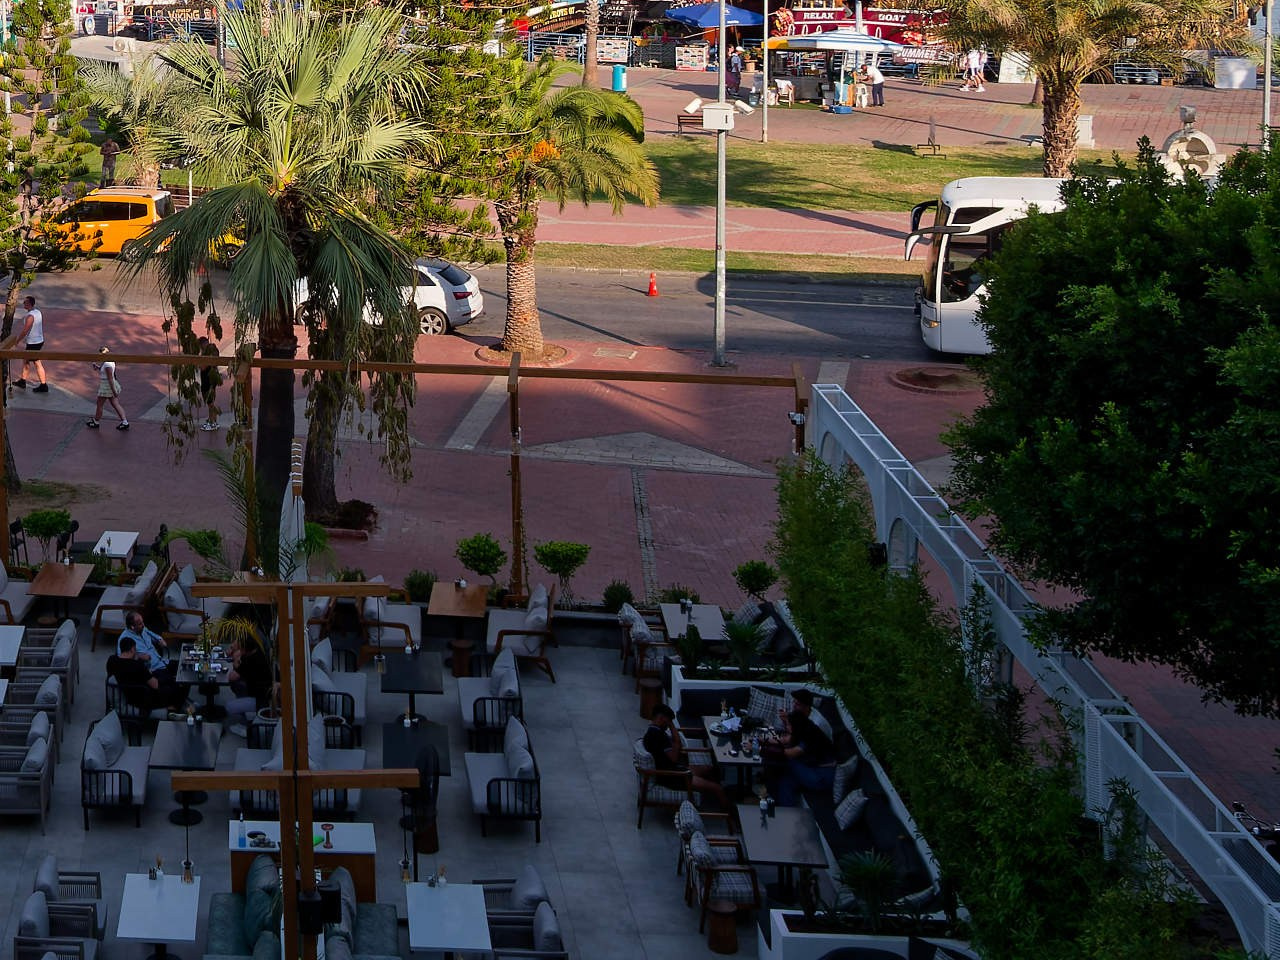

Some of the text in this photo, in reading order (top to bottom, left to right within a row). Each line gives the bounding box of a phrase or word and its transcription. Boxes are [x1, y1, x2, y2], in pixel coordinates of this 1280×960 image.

[168, 8, 200, 21] VIKING
[803, 12, 907, 21] RELAX BOAT
